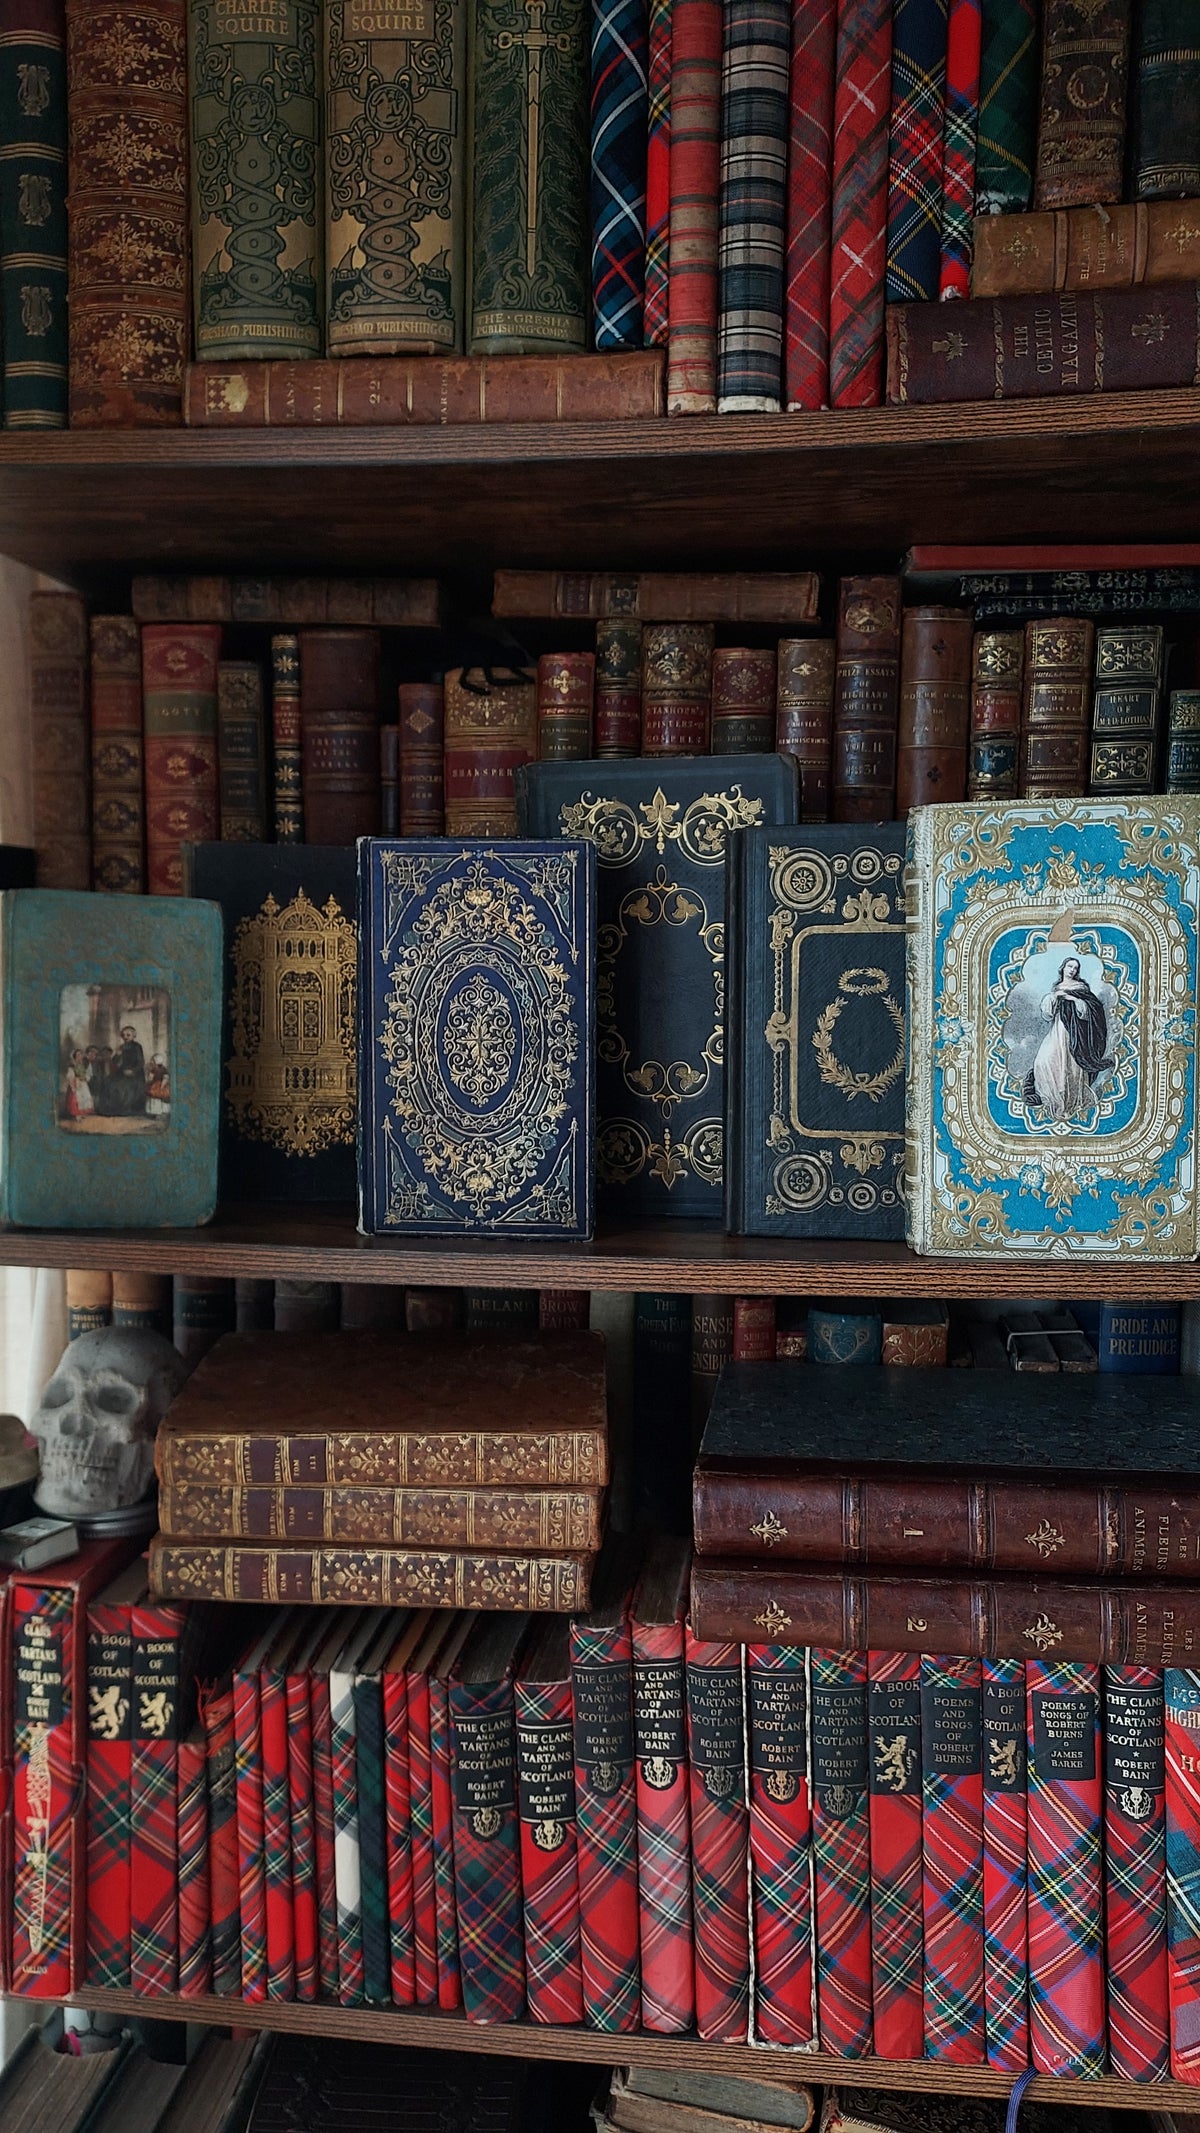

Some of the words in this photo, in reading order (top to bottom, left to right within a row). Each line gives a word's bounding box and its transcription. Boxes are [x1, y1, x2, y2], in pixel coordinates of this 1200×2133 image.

[215, 0, 287, 16] CHARLES
[351, 0, 424, 12] CHARLES
[216, 18, 289, 35] SQUIRE
[351, 15, 425, 32] SQUIRE
[478, 313, 505, 324] THE
[514, 314, 571, 327] GRESHA
[376, 320, 437, 335] PUBLISHING
[1014, 326, 1029, 358] THE
[1035, 308, 1053, 374] CELTIC
[865, 666, 896, 677] ESSAYS
[1109, 694, 1140, 704] HEART
[1116, 705, 1132, 714] OF
[452, 768, 513, 777] SHAKSPER
[540, 1299, 583, 1313] BROW
[654, 1298, 678, 1312] THE
[693, 1316, 734, 1334] SENSE
[1111, 1318, 1149, 1335] PRIDE
[1153, 1318, 1177, 1333] AND
[702, 1338, 727, 1350] AND
[1109, 1338, 1178, 1356] PREJUDICE
[288, 1505, 296, 1527] TOM
[903, 1527, 925, 1539] 1
[1156, 1515, 1170, 1572] FLEURS
[1178, 1537, 1188, 1560] LES
[906, 1616, 929, 1633] 2
[88, 1635, 97, 1645] A
[1160, 1610, 1175, 1665] FLEURS
[1184, 1629, 1194, 1652] LES
[136, 1644, 145, 1654] A
[146, 1643, 175, 1655] BOOK
[102, 1650, 119, 1661] OF
[149, 1659, 164, 1670] OF
[18, 1669, 62, 1685] SCOTLAND
[88, 1666, 131, 1678] COTLAN
[647, 1669, 682, 1682] CLANS
[574, 1673, 597, 1684] THE
[688, 1673, 708, 1688] THE
[593, 1685, 614, 1693] AND
[644, 1681, 664, 1689] AND
[752, 1680, 773, 1691] THE
[774, 1682, 805, 1693] CLAN
[872, 1683, 883, 1694] A
[886, 1681, 921, 1693] BOOK
[578, 1692, 629, 1704] TARTANS
[633, 1689, 681, 1700] ARTANS
[706, 1689, 726, 1697] AND
[770, 1692, 791, 1701] AND
[986, 1686, 996, 1698] A
[648, 1700, 662, 1709] OF
[691, 1694, 741, 1709] TARTANS
[754, 1699, 806, 1713] TARTANS
[889, 1698, 906, 1708] OF
[933, 1697, 975, 1707] POEMS
[1041, 1700, 1077, 1711] POEMS
[1078, 1702, 1087, 1711] &
[1106, 1693, 1127, 1707] THE
[1129, 1696, 1163, 1708] CLANS
[596, 1704, 609, 1712] OF
[633, 1708, 684, 1719] COTLAND
[710, 1708, 724, 1716] OF
[828, 1708, 849, 1716] AND
[942, 1709, 966, 1719] AND
[1000, 1704, 1016, 1715] OF
[1124, 1708, 1147, 1716] AND
[774, 1713, 787, 1721] OF
[813, 1715, 865, 1727] TARTANS
[1040, 1710, 1072, 1720] SONGS
[1076, 1711, 1090, 1720] OF
[1107, 1712, 1163, 1728] TARTANS
[1165, 1703, 1200, 1729] HIGH
[456, 1722, 477, 1734] THE
[480, 1719, 512, 1733] CLANS
[934, 1719, 974, 1730] SONGS
[1044, 1719, 1087, 1729] ROBERT
[475, 1733, 495, 1742] AND
[518, 1731, 539, 1745] THE
[540, 1730, 573, 1745] CLANS
[637, 1730, 677, 1741] ROBERT
[832, 1728, 846, 1736] OF
[946, 1732, 962, 1741] OF
[1047, 1729, 1083, 1739] BURNS
[1128, 1728, 1143, 1737] OF
[460, 1738, 511, 1753] TARTANS
[585, 1735, 625, 1745] ROBERT
[644, 1740, 671, 1751] BAIN
[700, 1738, 738, 1750] ROBERT
[1106, 1732, 1164, 1748] SCOTLAND
[536, 1744, 557, 1753] AND
[592, 1745, 618, 1756] BAIN
[760, 1743, 801, 1754] ROBERT
[932, 1742, 977, 1753] ROBERT
[479, 1752, 492, 1760] OF
[521, 1751, 573, 1764] TARTANS
[705, 1749, 732, 1759] BAIN
[767, 1753, 794, 1764] BAIN
[934, 1753, 973, 1764] BURNS
[1050, 1750, 1084, 1759] JAMES
[458, 1757, 512, 1771] SCOTLAND
[540, 1763, 553, 1772] OF
[818, 1758, 859, 1769] ROBERT
[1051, 1759, 1084, 1769] BARKE
[1114, 1758, 1157, 1770] ROBERT
[520, 1770, 575, 1784] SCOTLAND
[824, 1768, 852, 1778] BAIN
[1121, 1769, 1151, 1781] BAIN
[467, 1780, 506, 1792] ROBERT
[474, 1790, 499, 1802] BAIN
[528, 1793, 568, 1805] ROBERT
[534, 1803, 562, 1815] BAIN
